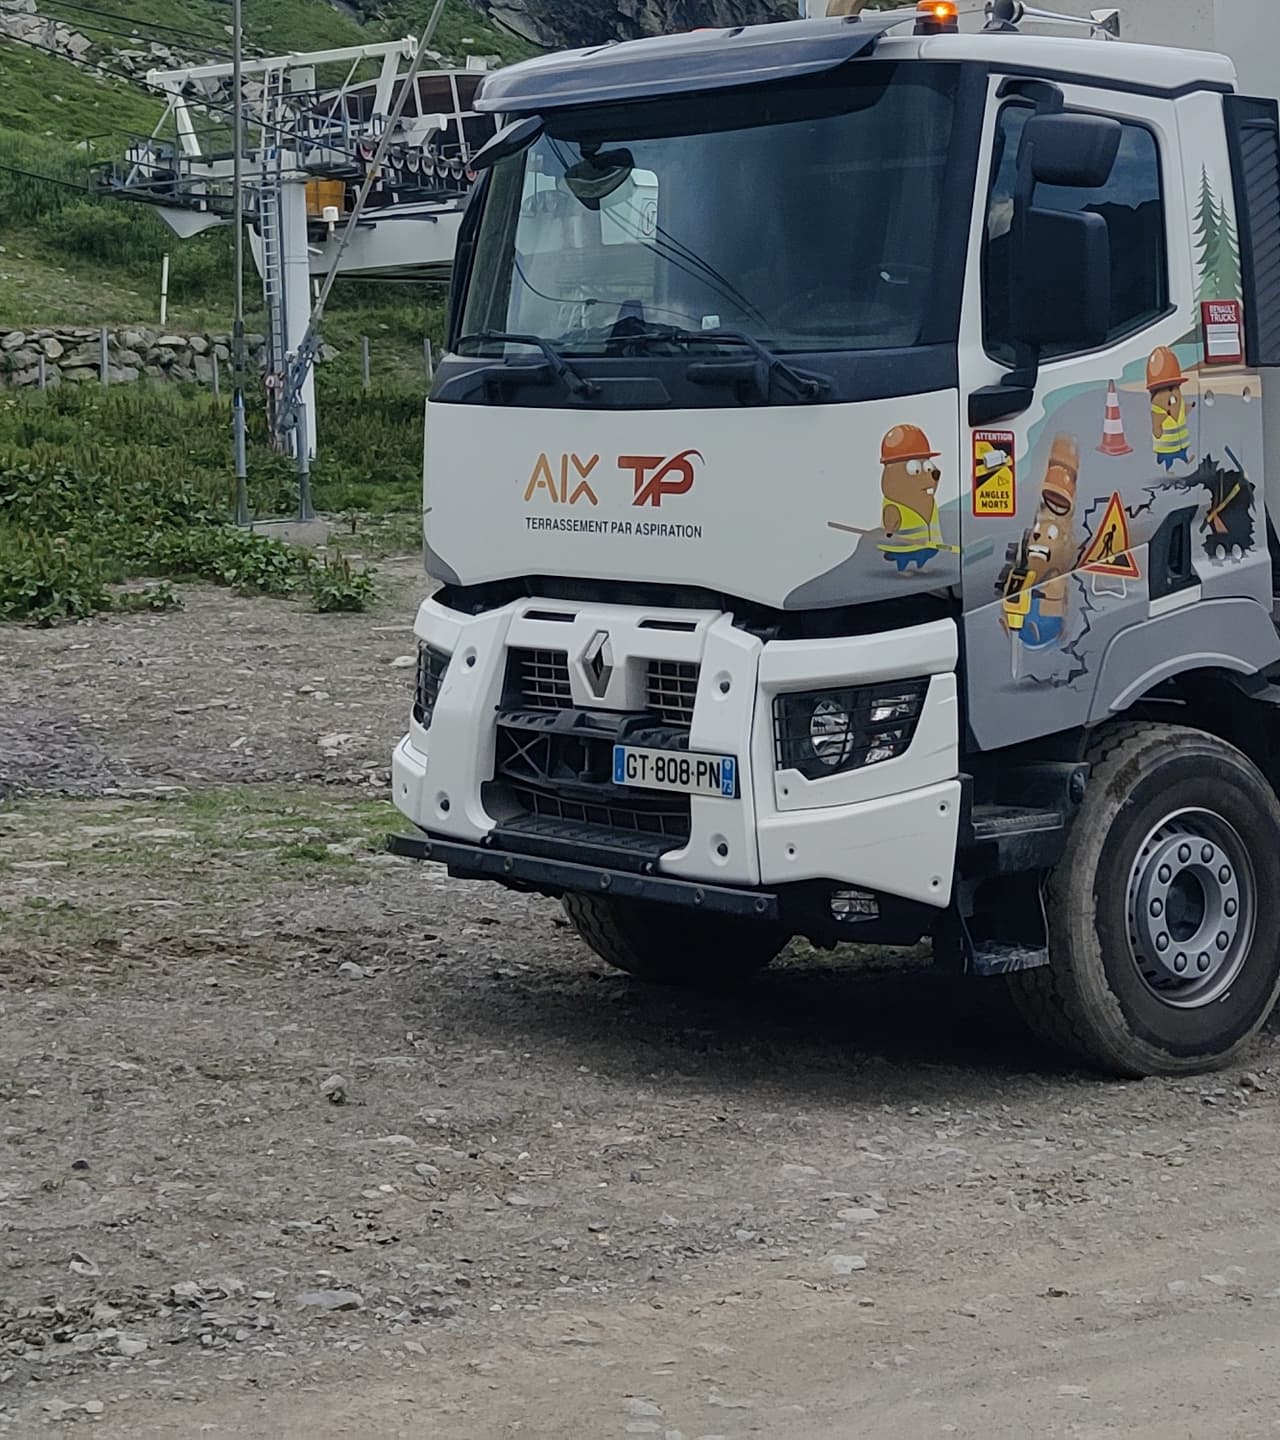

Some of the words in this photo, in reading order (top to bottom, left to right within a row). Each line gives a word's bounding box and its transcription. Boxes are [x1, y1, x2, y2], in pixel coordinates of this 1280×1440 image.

[1210, 313, 1237, 323] TRUCKS
[524, 453, 600, 506] AIX
[617, 449, 706, 507] TP
[980, 490, 1009, 500] ANGLES
[981, 500, 1008, 509] MORTS
[525, 517, 608, 535] TERRASSEMENT
[610, 521, 632, 536] PAR
[634, 523, 702, 539] ASPIRATION
